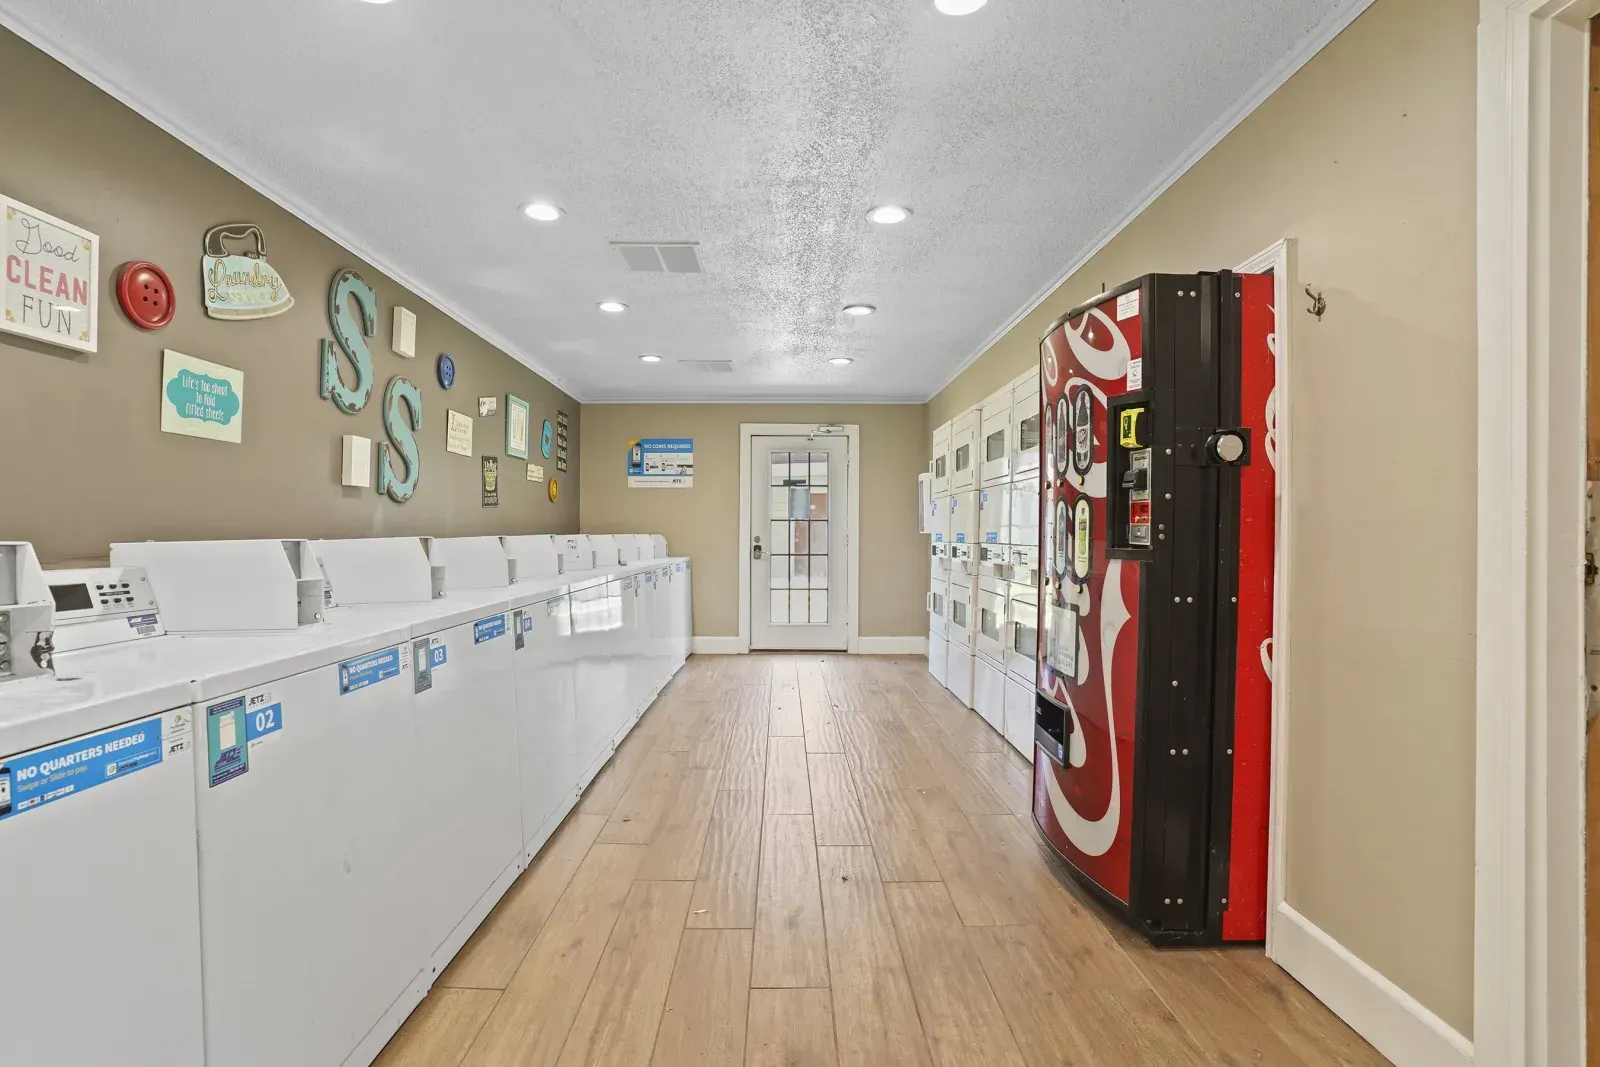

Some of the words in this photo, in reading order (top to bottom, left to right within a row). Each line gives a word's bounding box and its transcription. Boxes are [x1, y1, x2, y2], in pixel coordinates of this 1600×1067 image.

[15, 217, 80, 263] Good
[6, 254, 88, 306] CLEAN
[208, 258, 282, 304] Laundry
[22, 294, 72, 335] FUN
[320, 268, 378, 415] S
[378, 375, 422, 504] S
[349, 666, 356, 674] NO
[356, 659, 378, 672] QUARTERS
[378, 654, 393, 665] NEEDED
[434, 648, 444, 663] 03
[249, 694, 264, 706] JETZ
[256, 710, 275, 731] 02
[16, 767, 38, 782] NO
[39, 746, 104, 776] QUARTERS
[104, 731, 145, 755] NEEDED
[168, 742, 184, 754] JETZ
[67, 768, 75, 777] to
